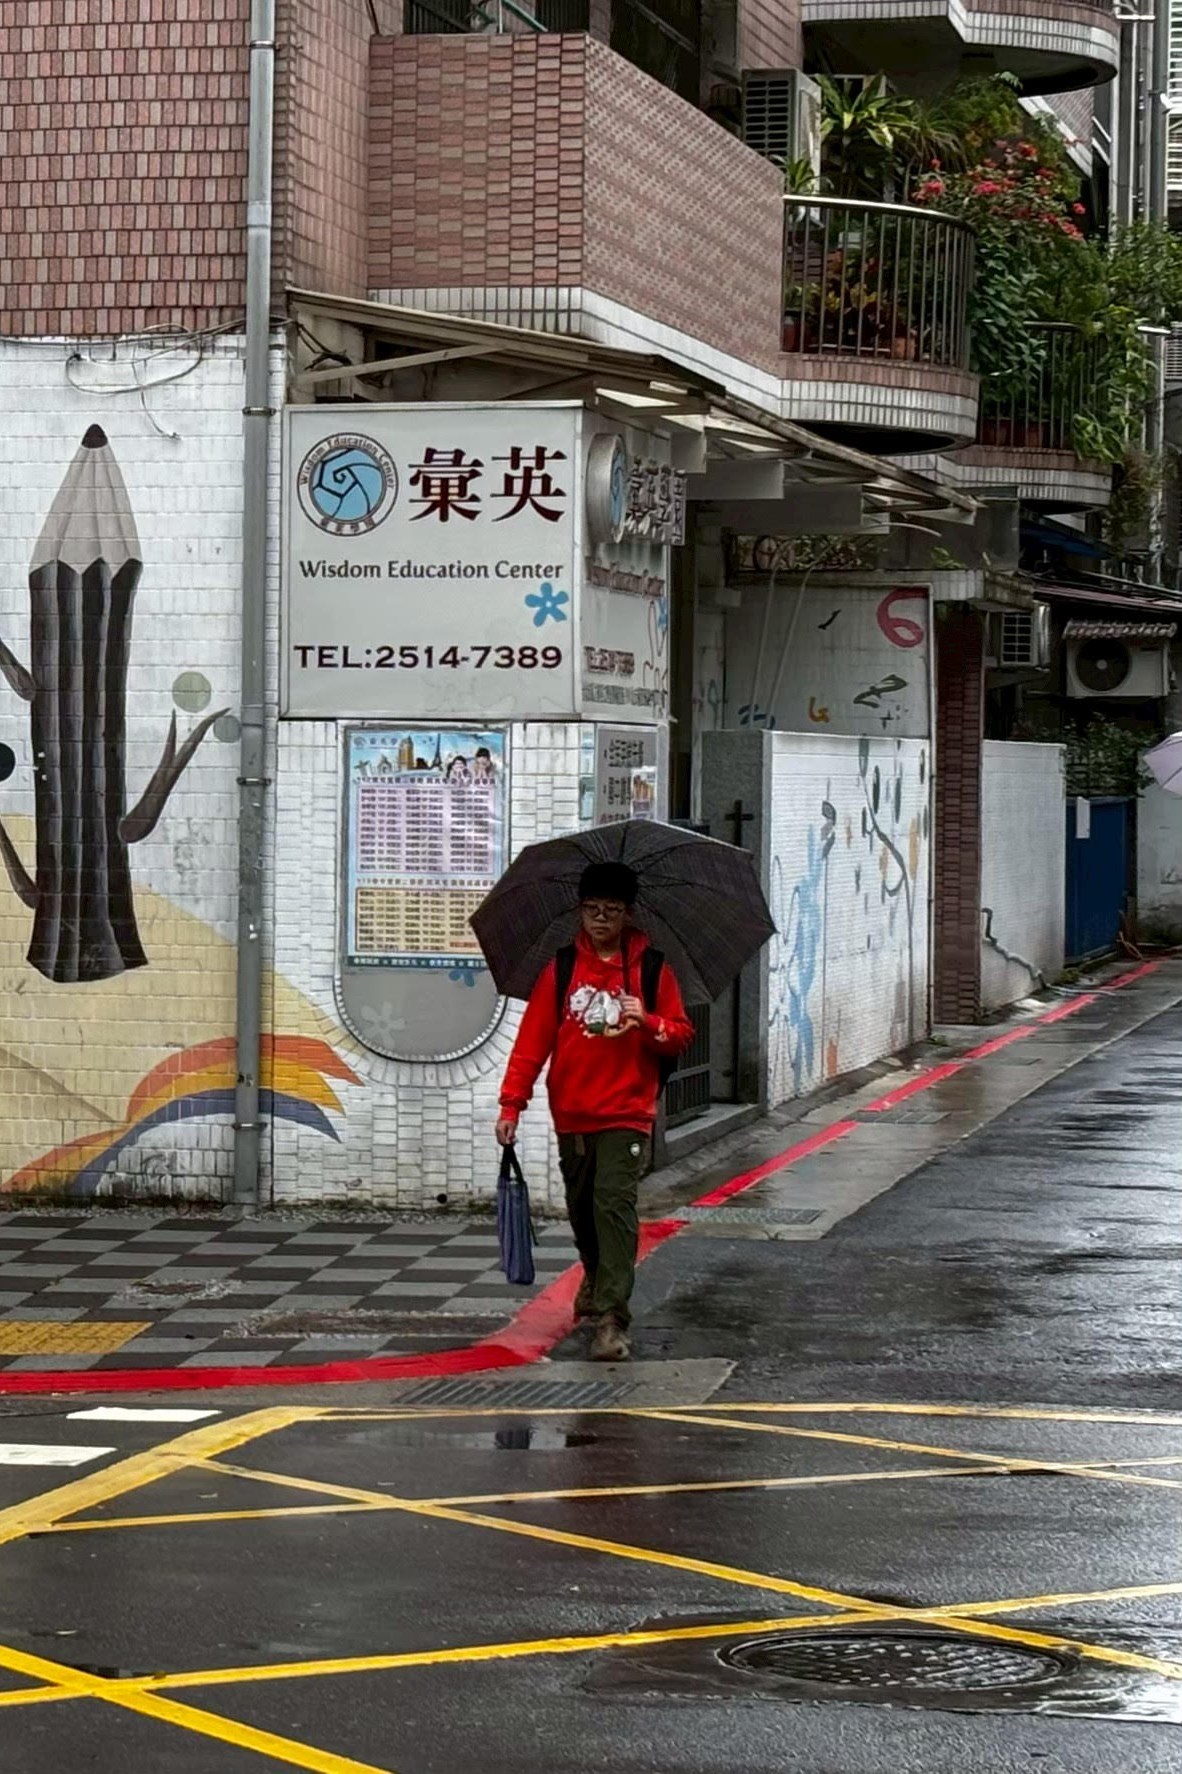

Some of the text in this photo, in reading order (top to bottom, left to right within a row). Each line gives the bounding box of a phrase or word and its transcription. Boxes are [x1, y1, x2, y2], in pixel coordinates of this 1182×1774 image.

[408, 445, 568, 523] 彙英
[298, 560, 381, 579] Wisdom
[387, 560, 490, 579] Education
[495, 560, 564, 579] Center
[294, 645, 563, 670] TEL:2514-7389
